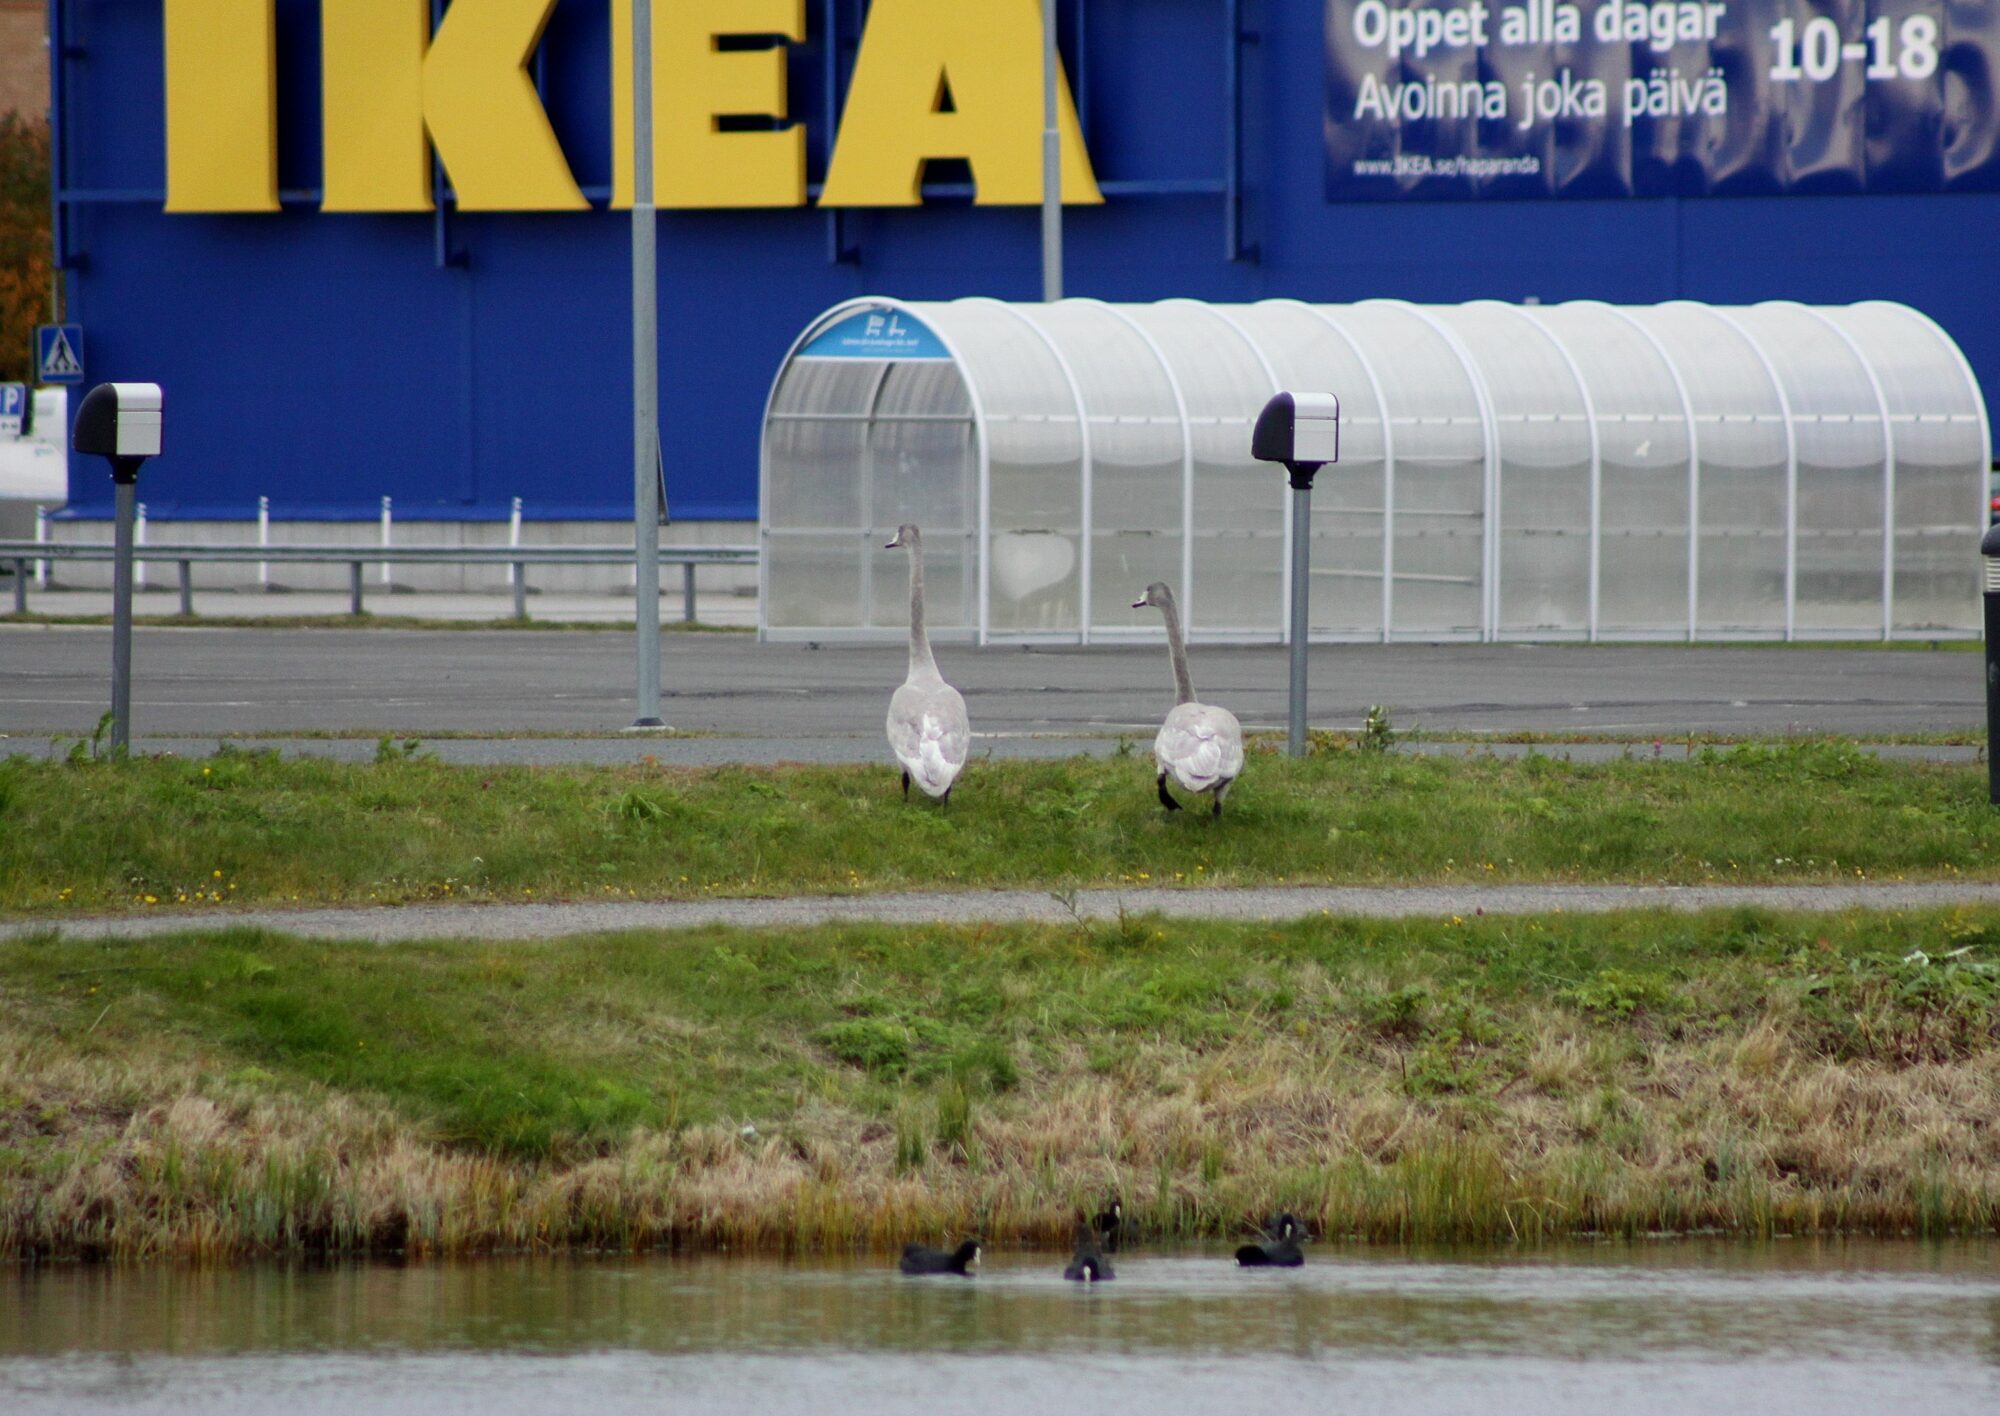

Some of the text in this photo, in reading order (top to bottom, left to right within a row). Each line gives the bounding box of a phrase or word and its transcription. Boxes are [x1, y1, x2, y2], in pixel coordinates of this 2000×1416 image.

[1500, 0, 1580, 44] alla
[1594, 0, 1726, 51] dagar
[1769, 14, 1938, 81] 10-18
[163, 0, 1105, 213] IKEA
[1354, 68, 1727, 130] Avoinna joka päivä
